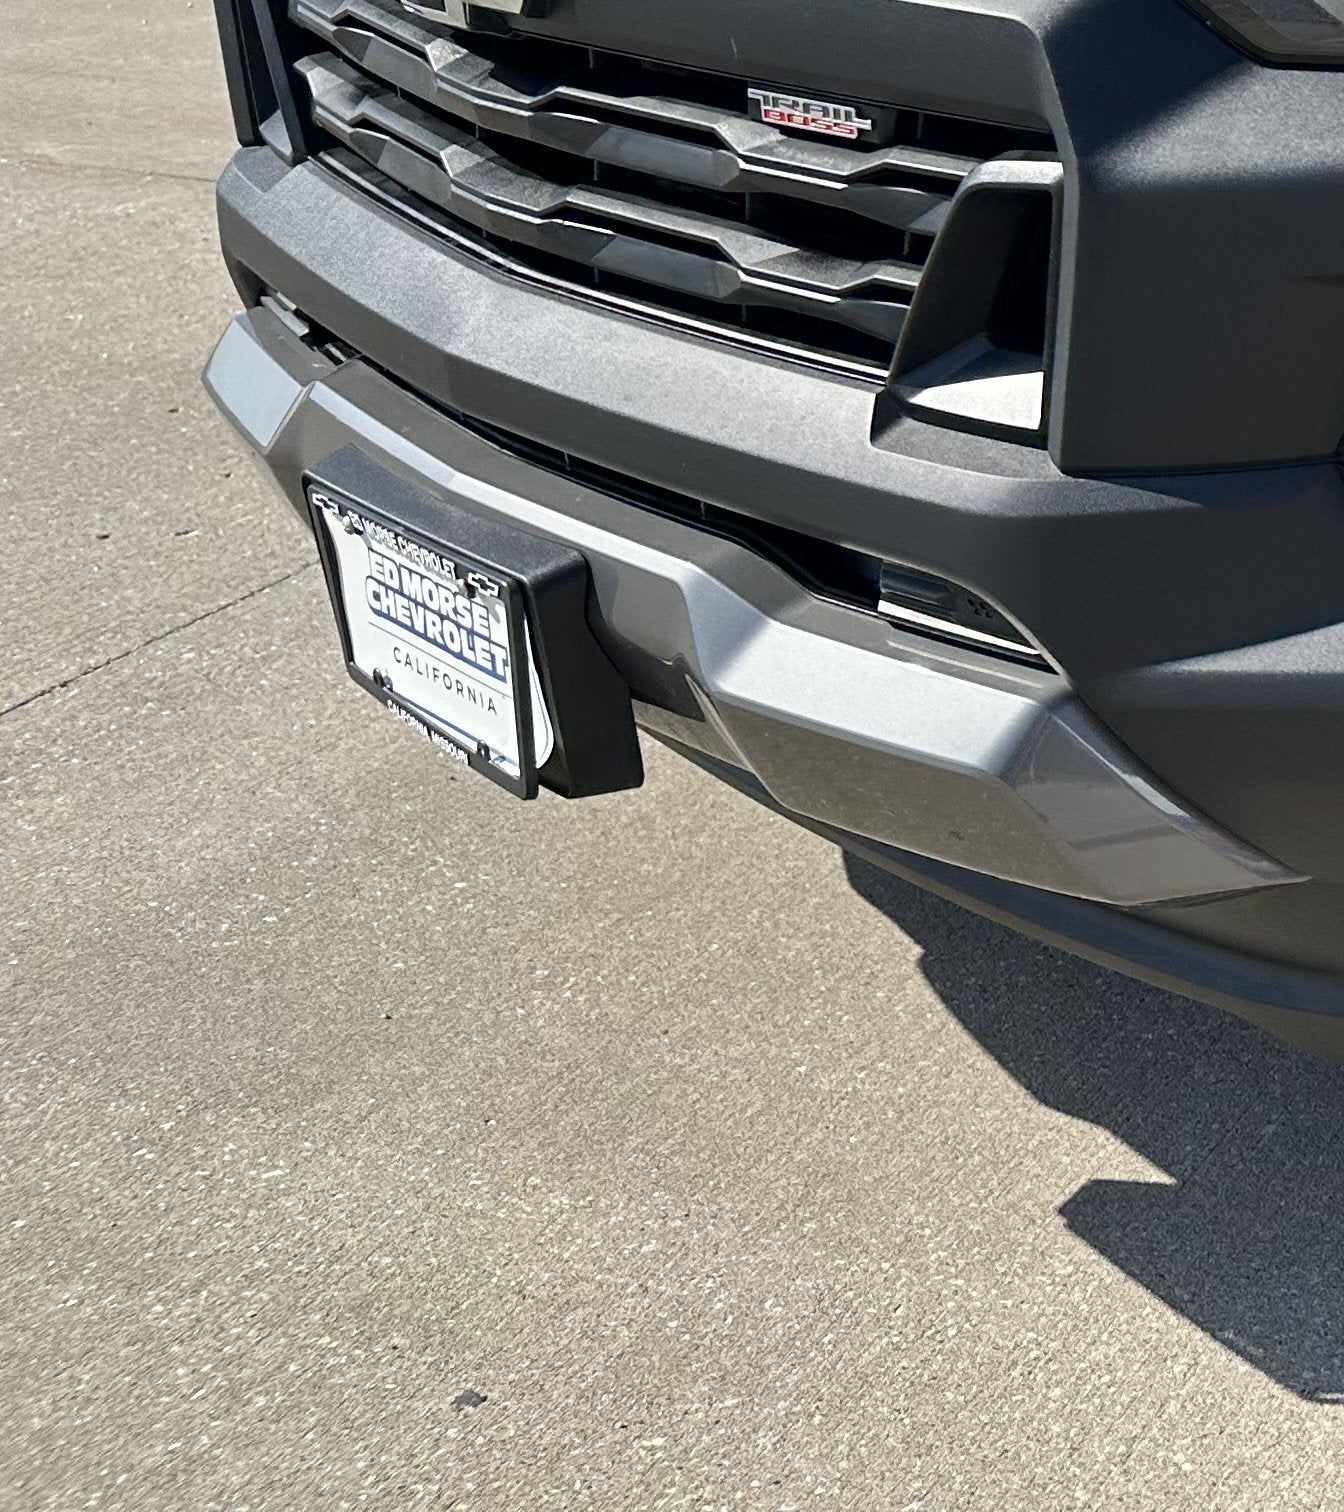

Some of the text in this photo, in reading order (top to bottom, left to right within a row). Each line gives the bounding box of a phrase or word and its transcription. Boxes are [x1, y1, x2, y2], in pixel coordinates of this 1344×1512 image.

[748, 88, 872, 130] TRAIL
[762, 108, 858, 139] BOSS
[397, 536, 456, 580] CHEVROLET
[368, 550, 490, 637] ED MORSE
[367, 578, 507, 682] CHEVROLET
[393, 646, 497, 715] CALIFORNIA
